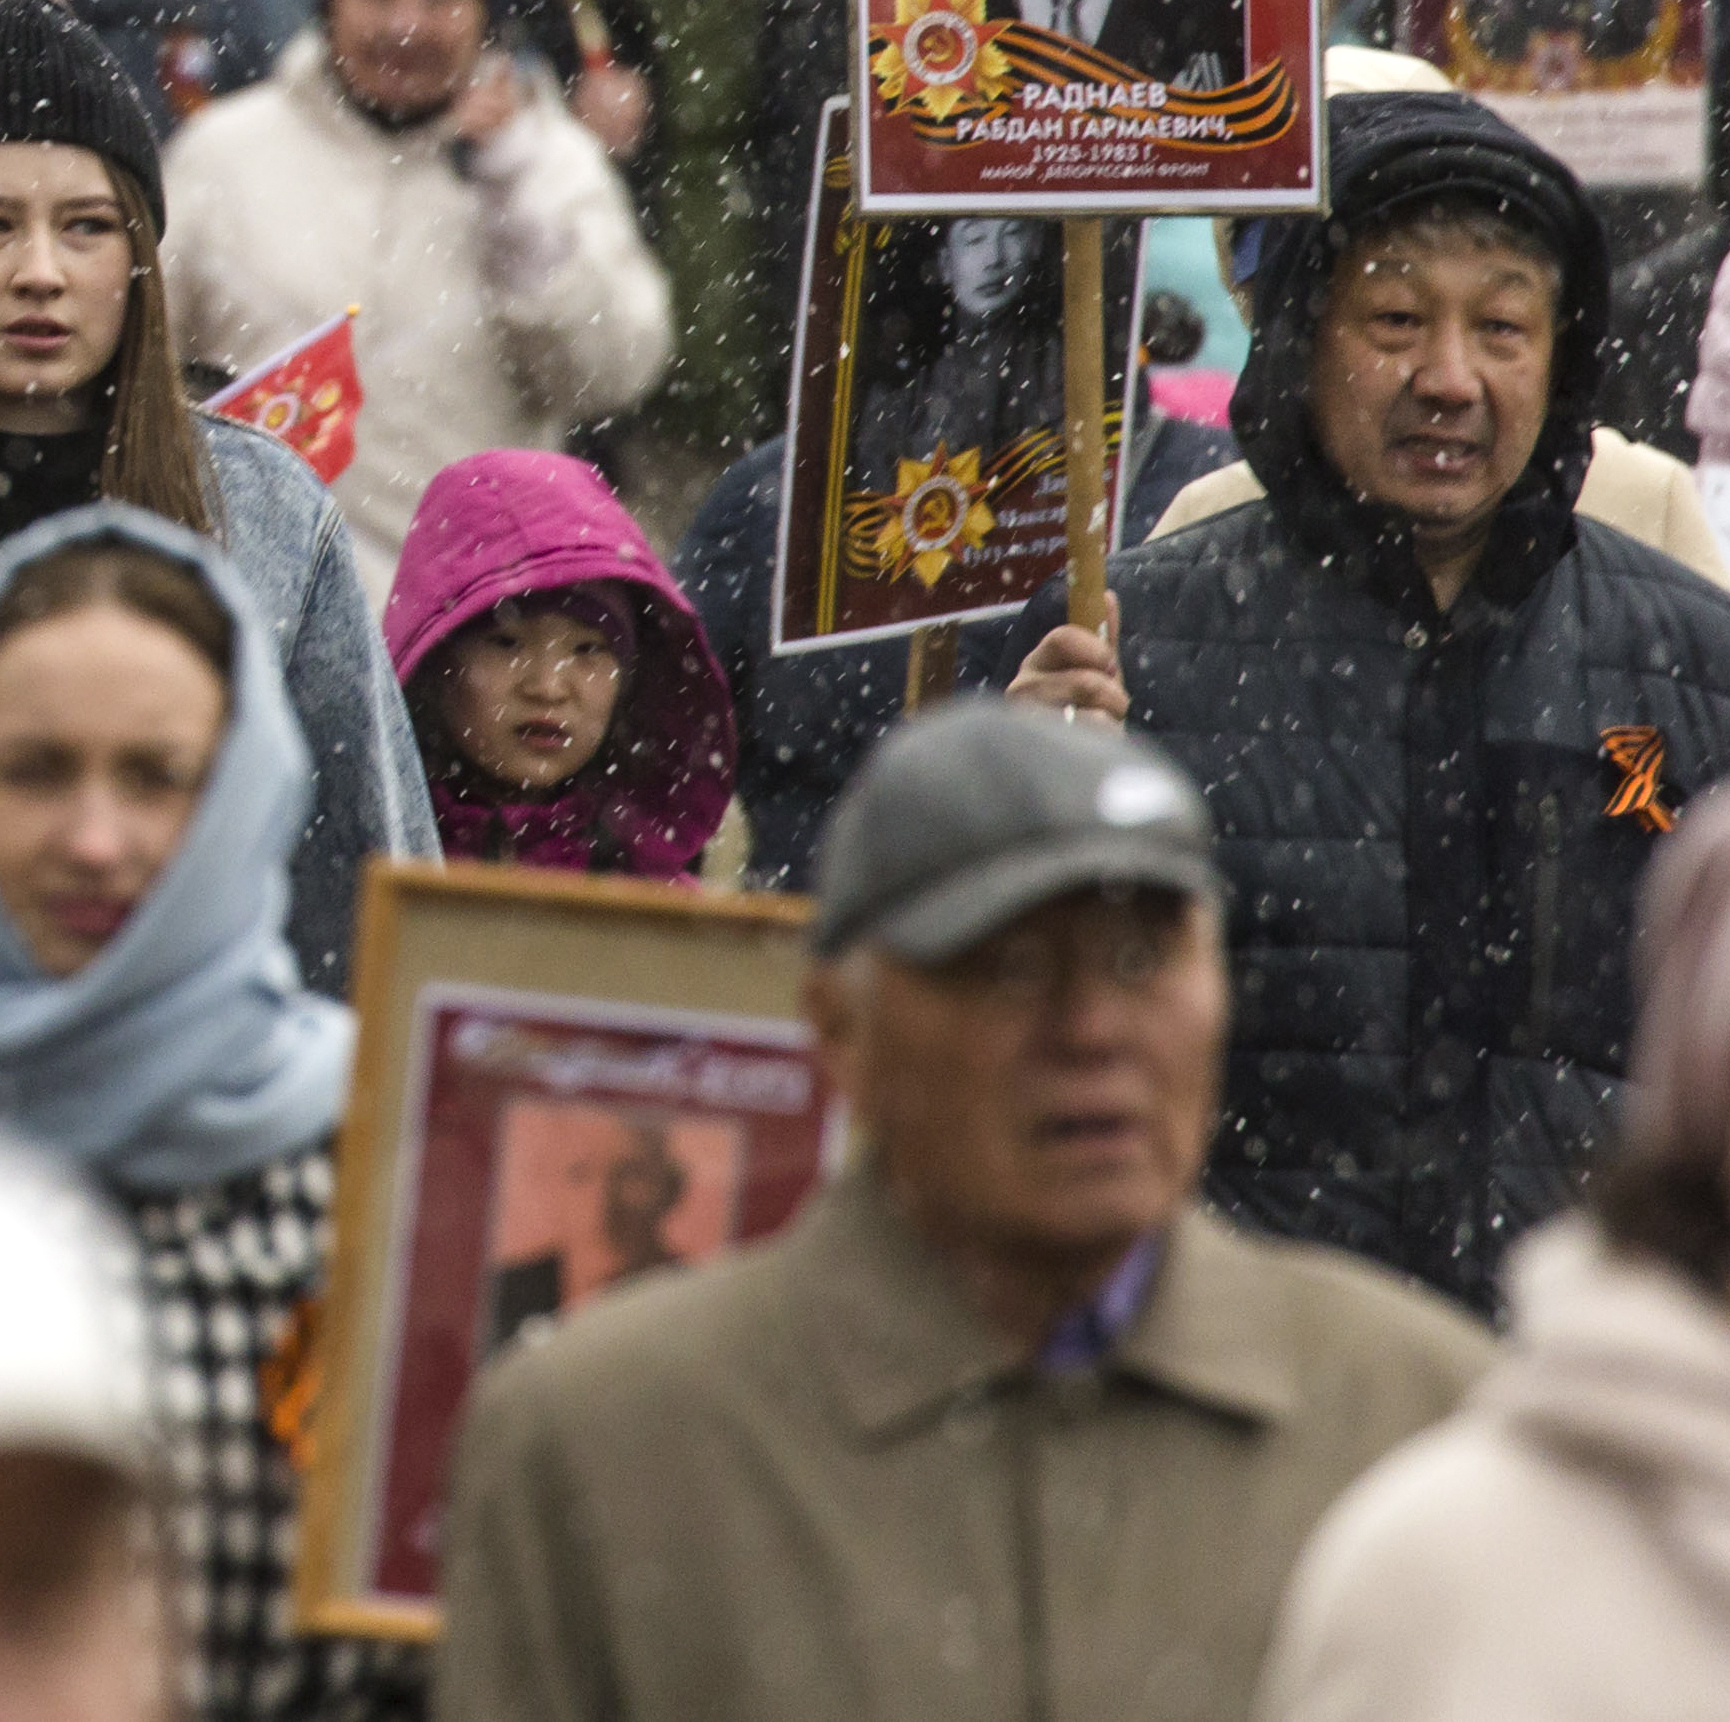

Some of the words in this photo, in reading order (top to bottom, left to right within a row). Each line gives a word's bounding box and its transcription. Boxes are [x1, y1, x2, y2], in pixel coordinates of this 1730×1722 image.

[1021, 81, 1167, 112] РАДНАЕВ
[956, 116, 1063, 143] РАБДАН
[1069, 115, 1233, 141] ГАРМАЕВИЧ,
